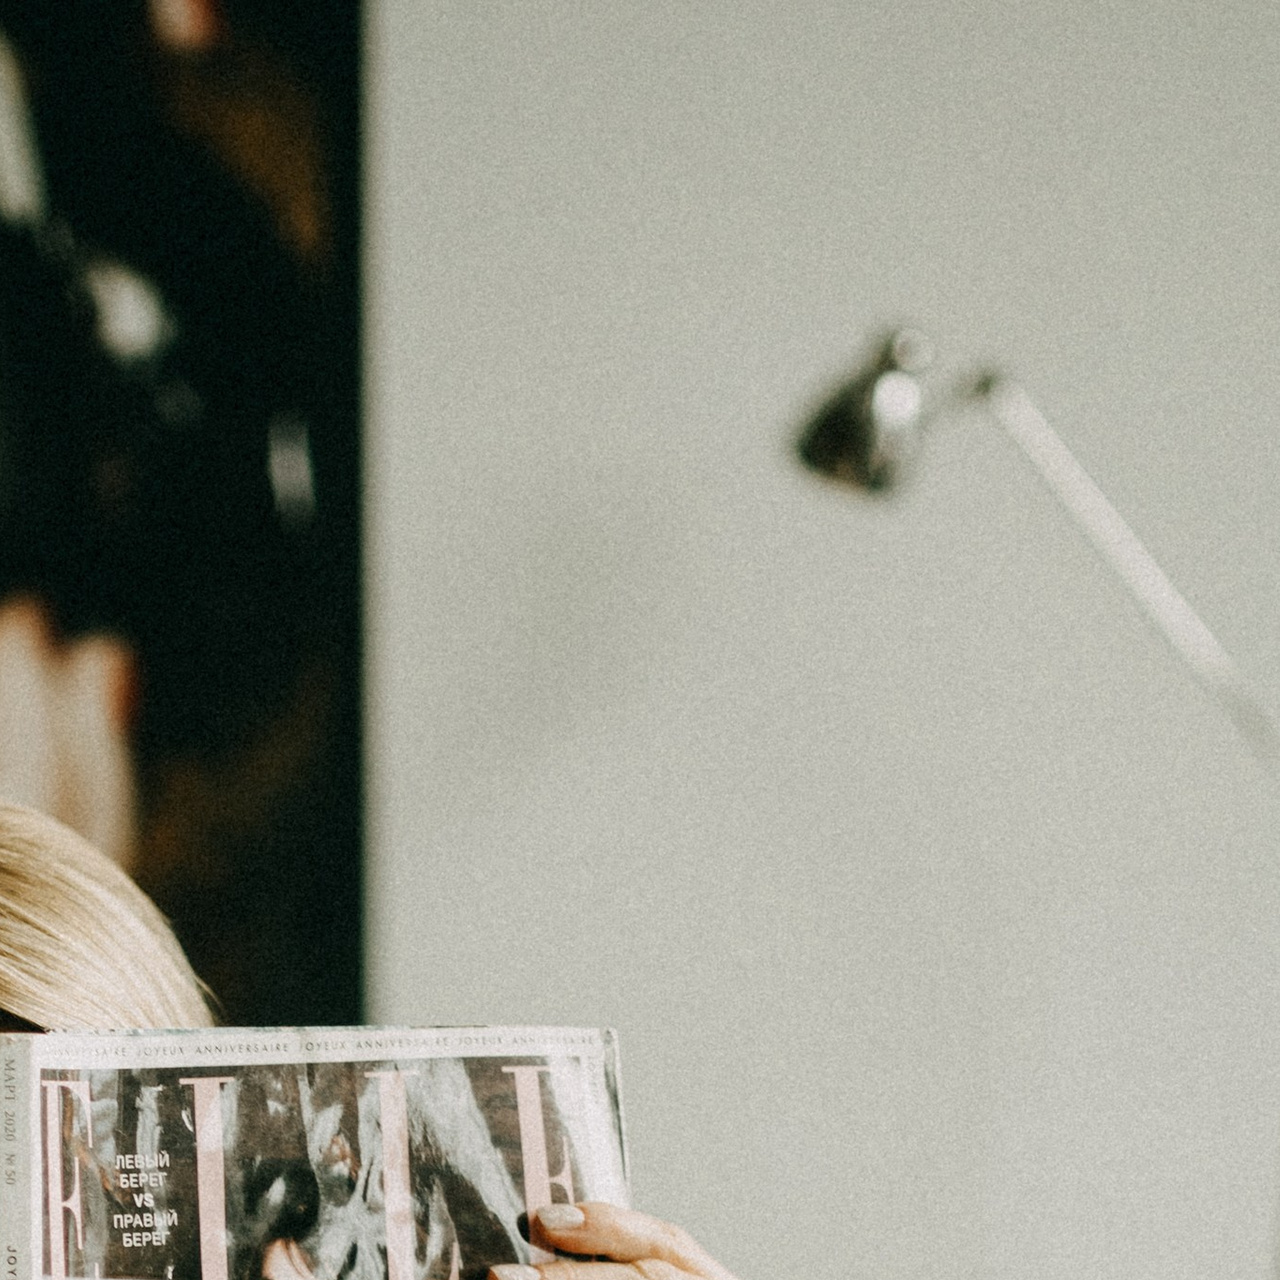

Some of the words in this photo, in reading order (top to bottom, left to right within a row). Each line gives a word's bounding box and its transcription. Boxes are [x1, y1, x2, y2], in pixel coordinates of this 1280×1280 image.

[195, 1041, 288, 1056] ANNIVERSAIRE
[4, 1110, 17, 1142] 2020
[115, 1149, 171, 1170] ЛЕВЫЙ
[120, 1171, 168, 1189] БЕРЕГ
[132, 1192, 155, 1208] VS
[113, 1208, 179, 1229] ПРАВЫЙ
[122, 1231, 171, 1248] БЕРЕГ
